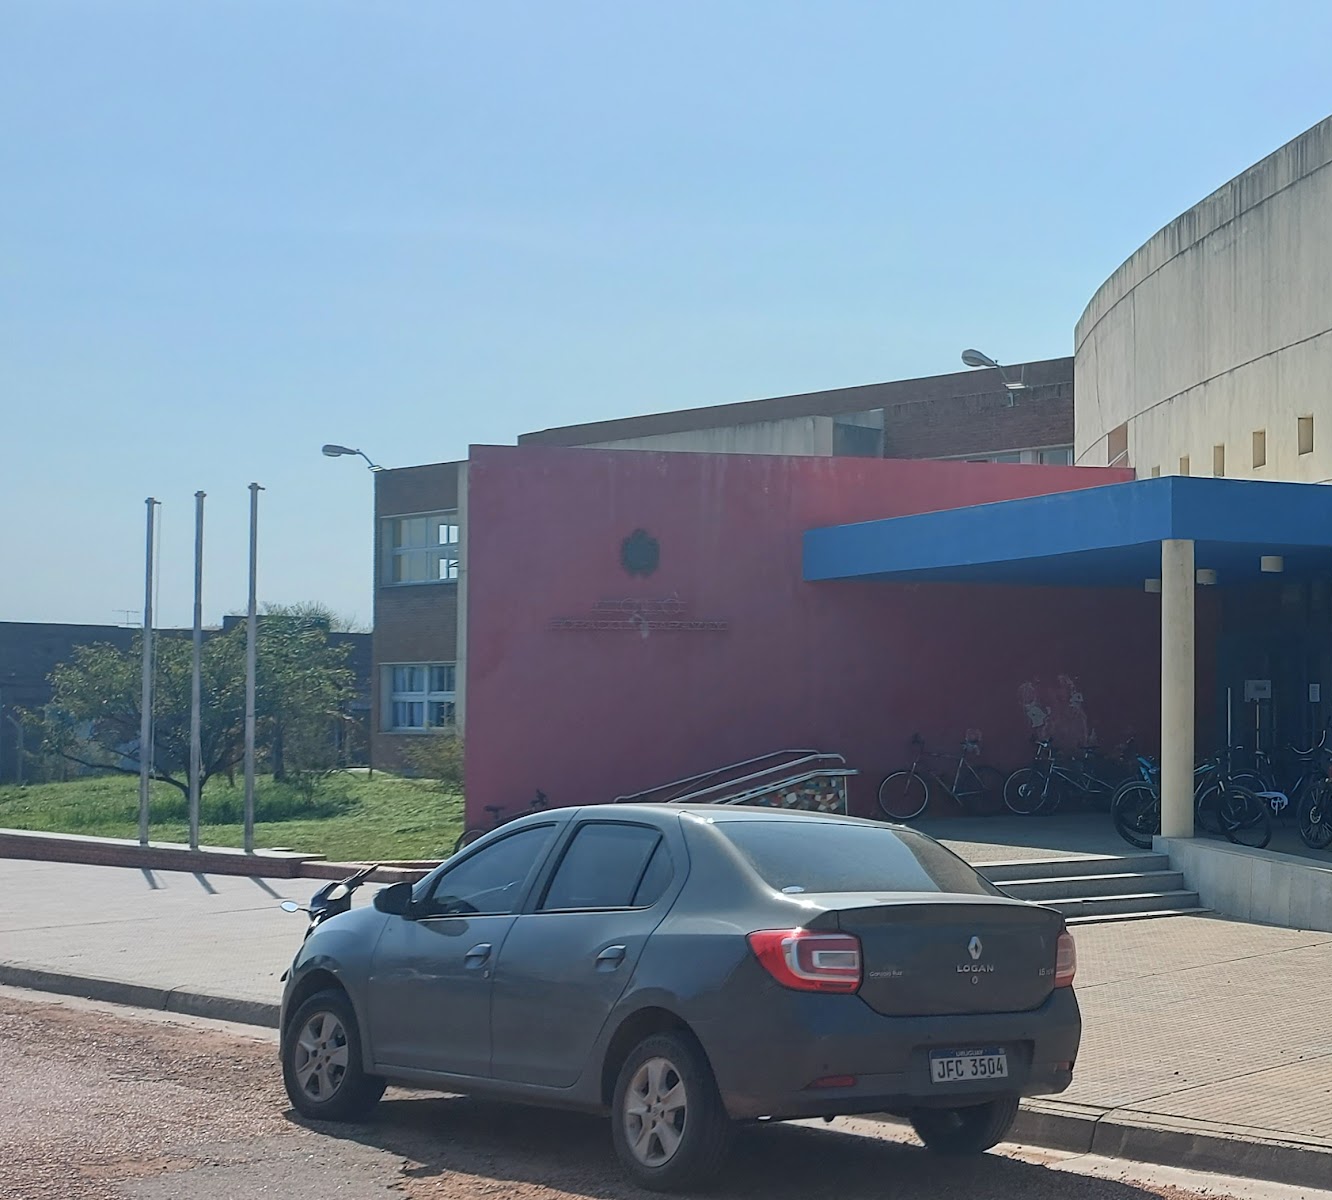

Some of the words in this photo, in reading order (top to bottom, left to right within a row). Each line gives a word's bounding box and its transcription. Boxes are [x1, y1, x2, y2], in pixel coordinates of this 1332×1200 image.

[956, 964, 994, 973] LOGAN
[955, 1049, 984, 1057] URUGUAY
[937, 1059, 964, 1079] JFC
[969, 1057, 1004, 1077] 3504
